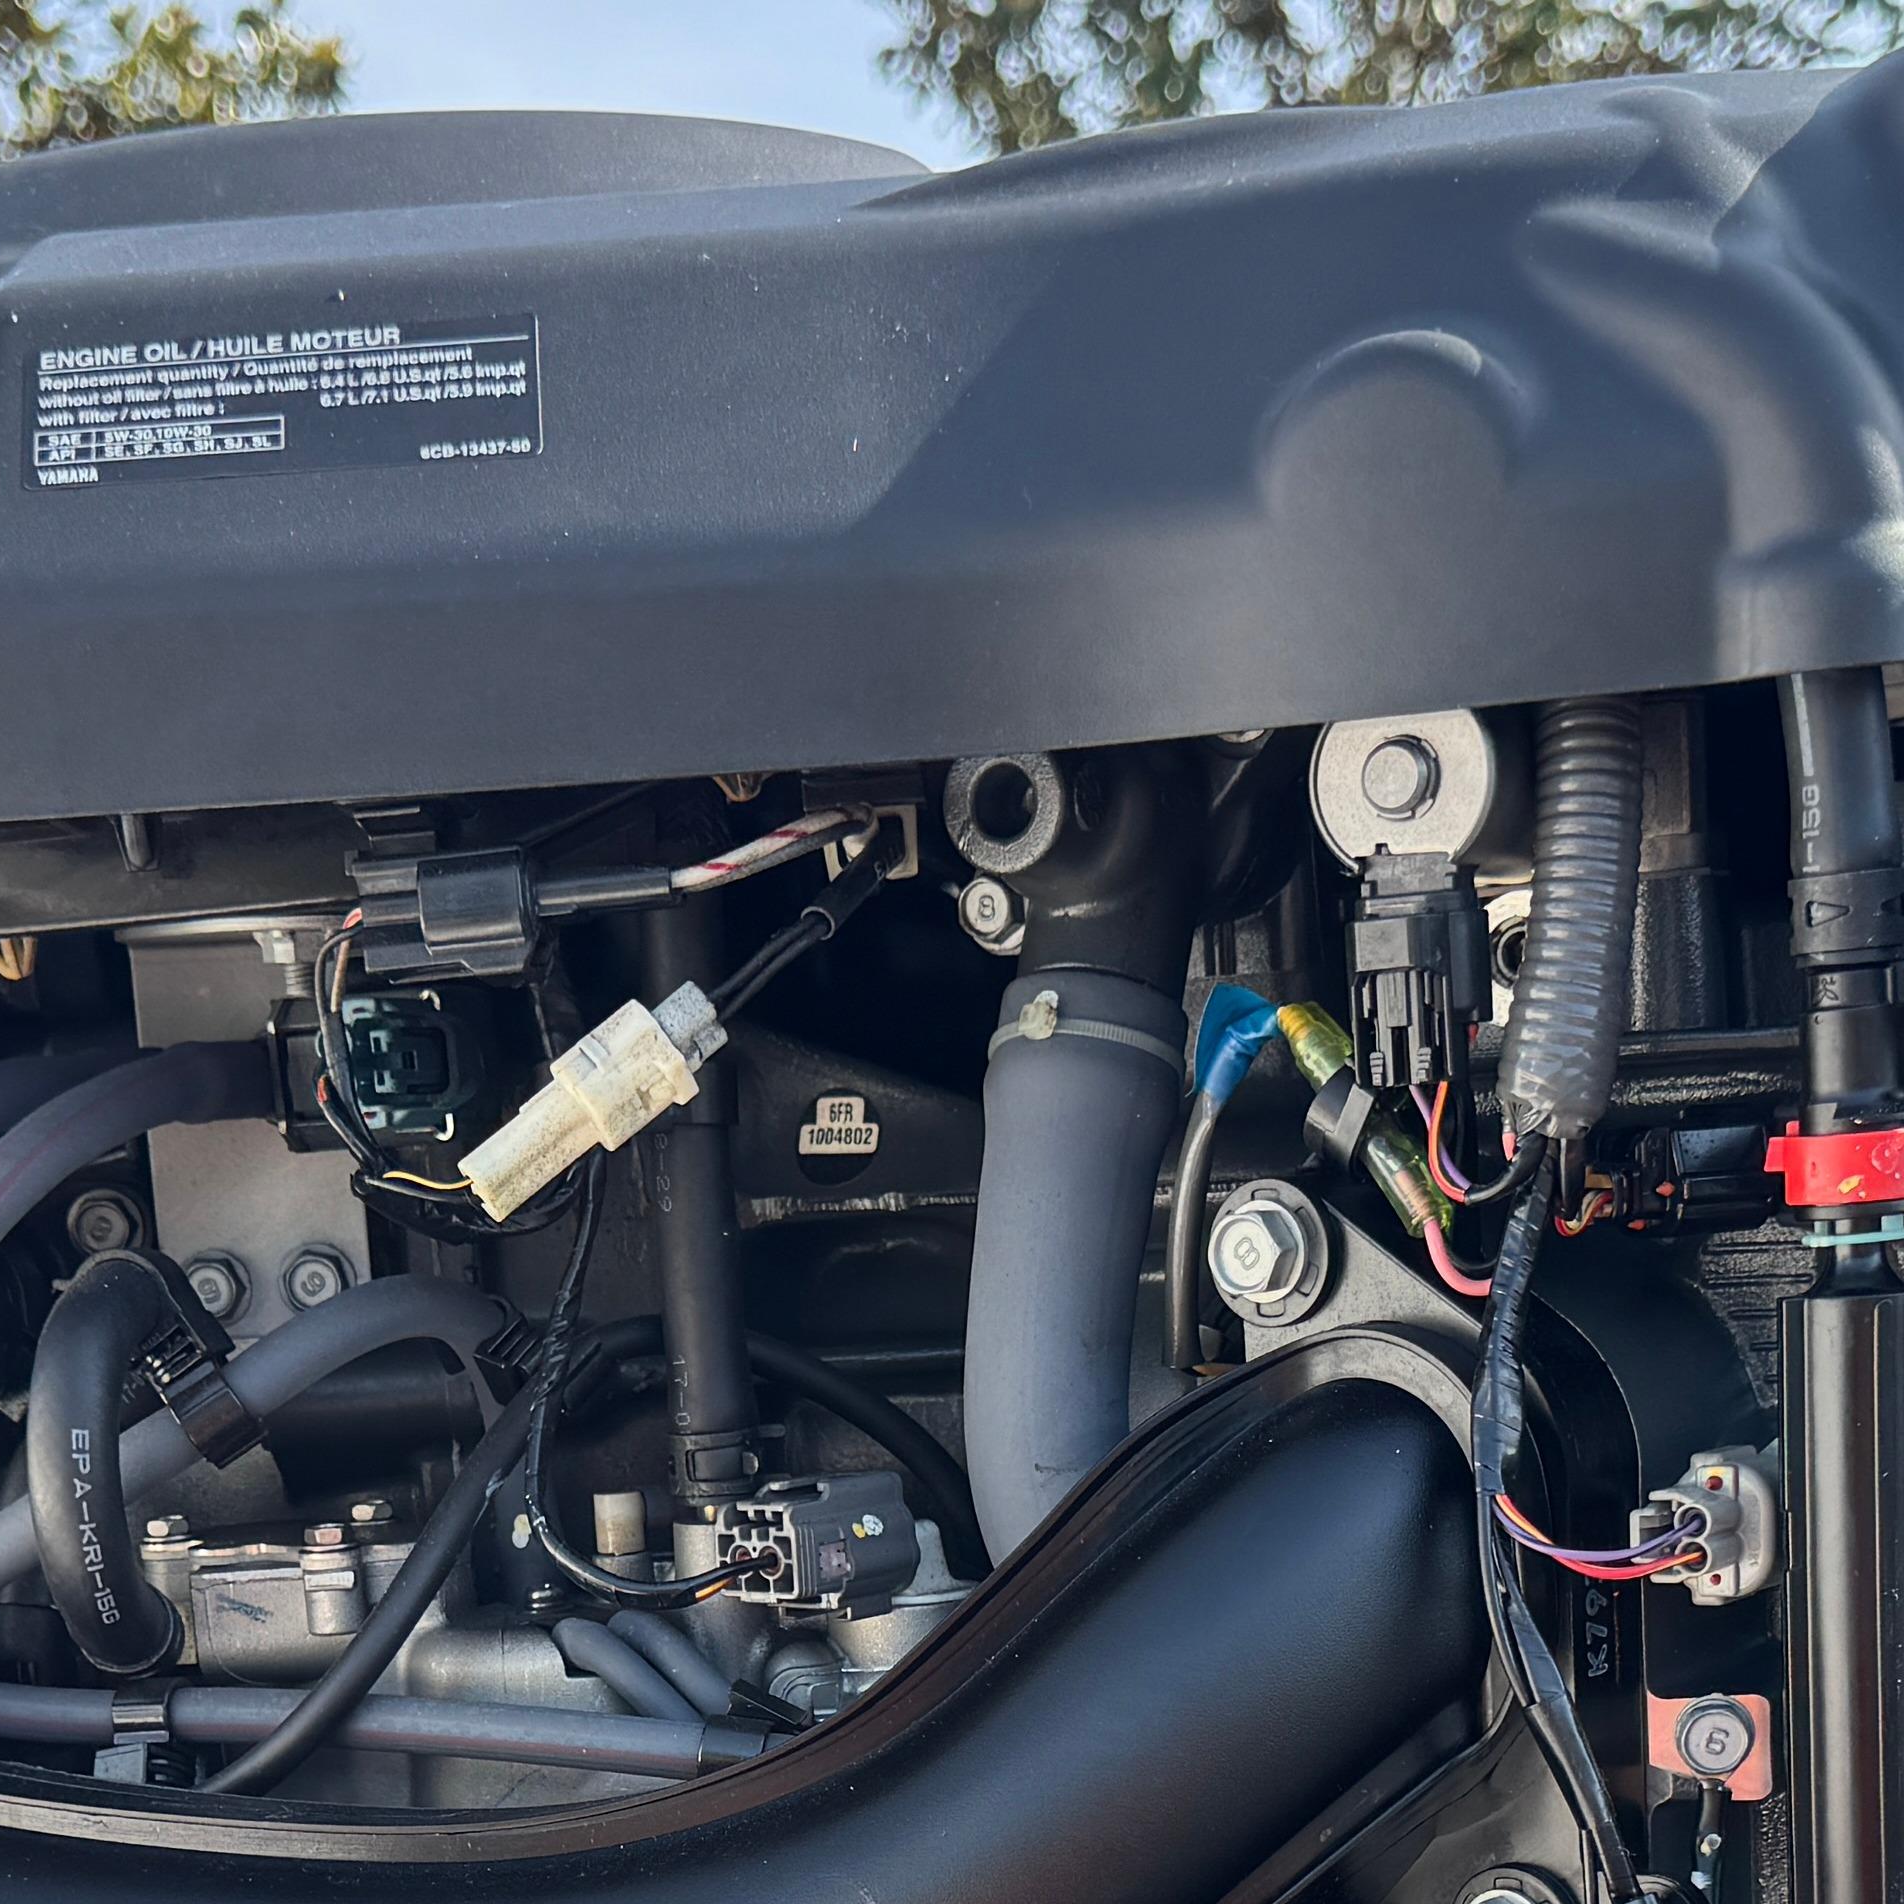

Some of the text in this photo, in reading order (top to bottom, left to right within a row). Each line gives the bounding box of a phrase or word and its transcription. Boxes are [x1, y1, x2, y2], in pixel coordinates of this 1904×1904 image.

[40, 345, 137, 370] ENGINE
[146, 341, 186, 362] OIL
[207, 334, 283, 357] HUILE
[291, 325, 400, 351] MOTEUR
[39, 370, 152, 391] Replacement
[157, 365, 227, 384] quantity
[321, 355, 345, 370] de
[349, 346, 472, 370] remplacement
[39, 391, 99, 409] without
[101, 389, 122, 404] oil
[37, 409, 75, 427] with
[48, 433, 81, 447] SAE
[48, 449, 76, 462] API
[37, 465, 99, 485] YAMAHA
[979, 895, 995, 920] 8
[829, 1103, 853, 1122] 6FR
[808, 1127, 873, 1145] 1004802
[1234, 1237, 1260, 1270] 8
